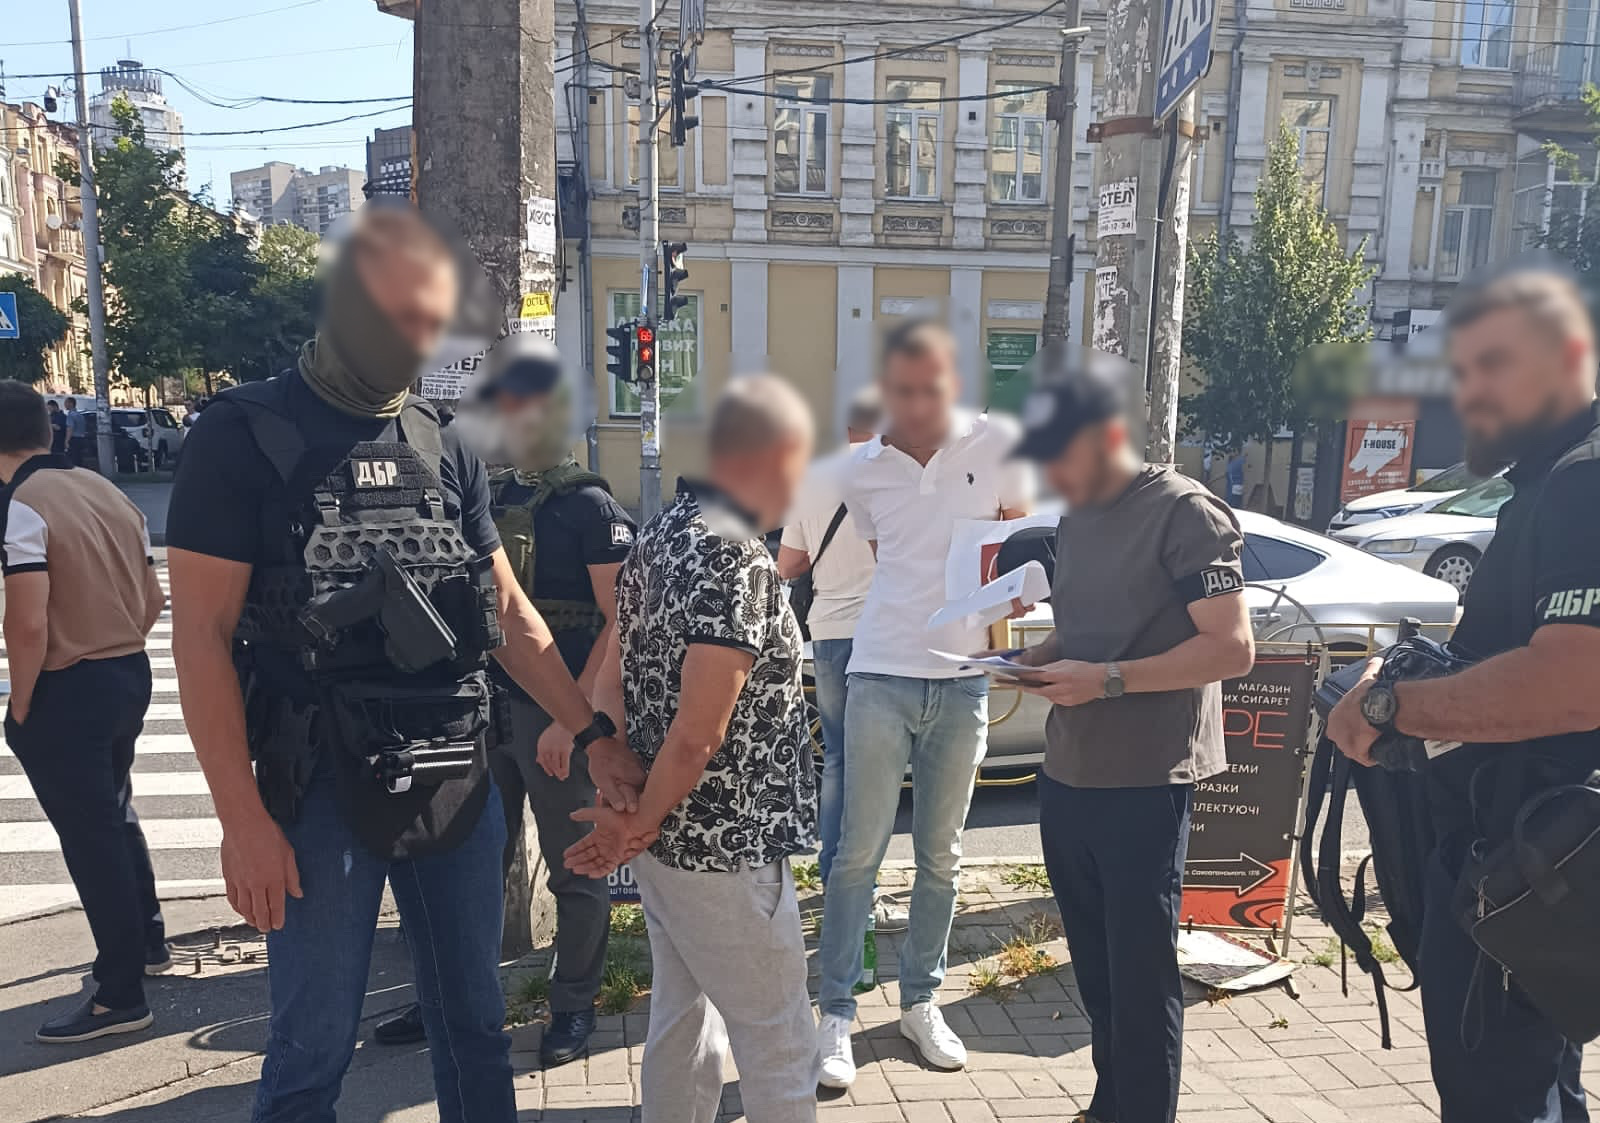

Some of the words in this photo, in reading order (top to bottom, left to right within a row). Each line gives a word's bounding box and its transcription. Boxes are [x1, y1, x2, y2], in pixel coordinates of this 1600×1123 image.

[1363, 439, 1397, 450] T-HOUSE
[357, 461, 398, 487] ДБР
[1543, 587, 1600, 620] ДБР
[1238, 682, 1291, 694] МАГАЗИН
[1241, 695, 1291, 706] СИГАРЕТ
